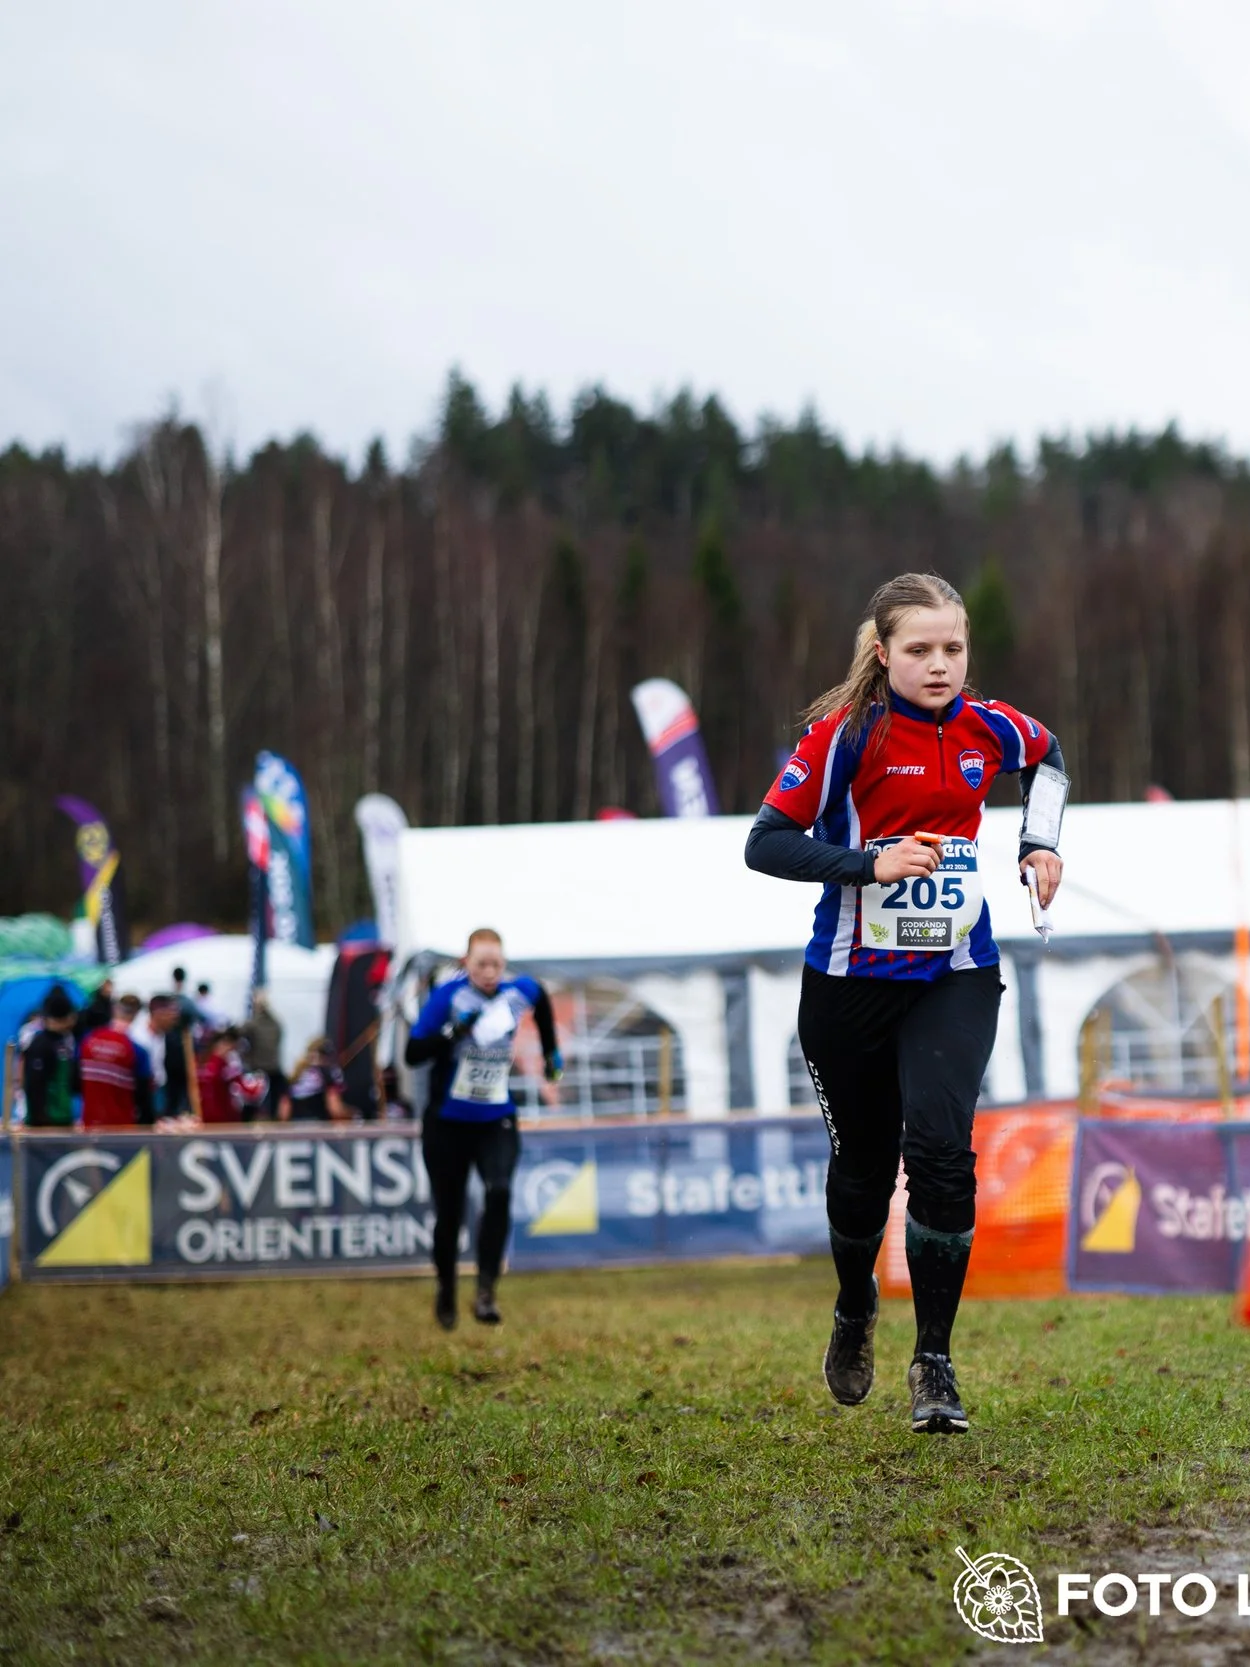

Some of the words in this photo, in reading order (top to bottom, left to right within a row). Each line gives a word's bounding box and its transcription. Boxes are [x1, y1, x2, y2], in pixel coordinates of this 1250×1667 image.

[886, 766, 925, 775] TRIMTEX
[881, 877, 965, 910] 205
[901, 928, 947, 937] AVLOPP
[176, 1211, 470, 1264] ORIENTERIN
